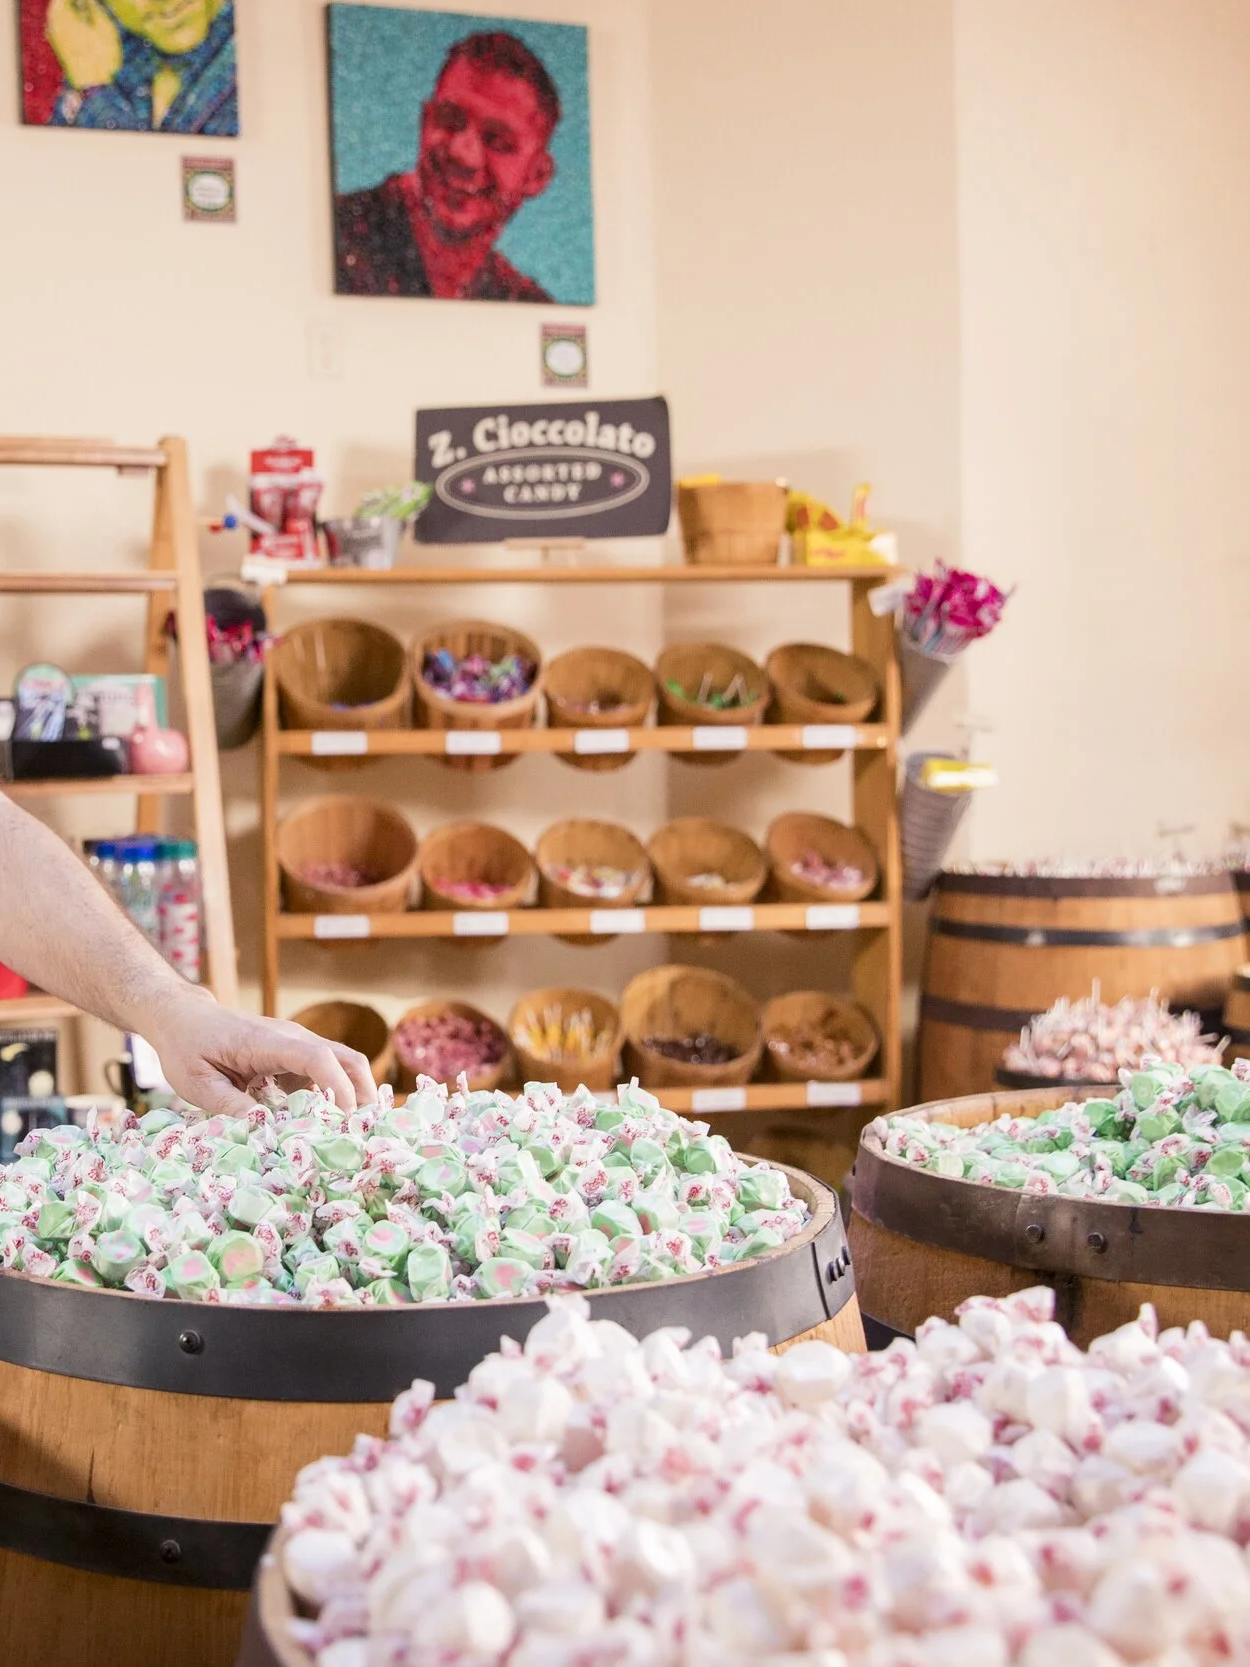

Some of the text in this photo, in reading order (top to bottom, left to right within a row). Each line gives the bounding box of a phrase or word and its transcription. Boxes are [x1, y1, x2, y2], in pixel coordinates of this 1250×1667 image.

[427, 410, 656, 469] Z. Cioccolato
[482, 461, 602, 485] ASSORTED
[503, 482, 583, 504] CANDY
